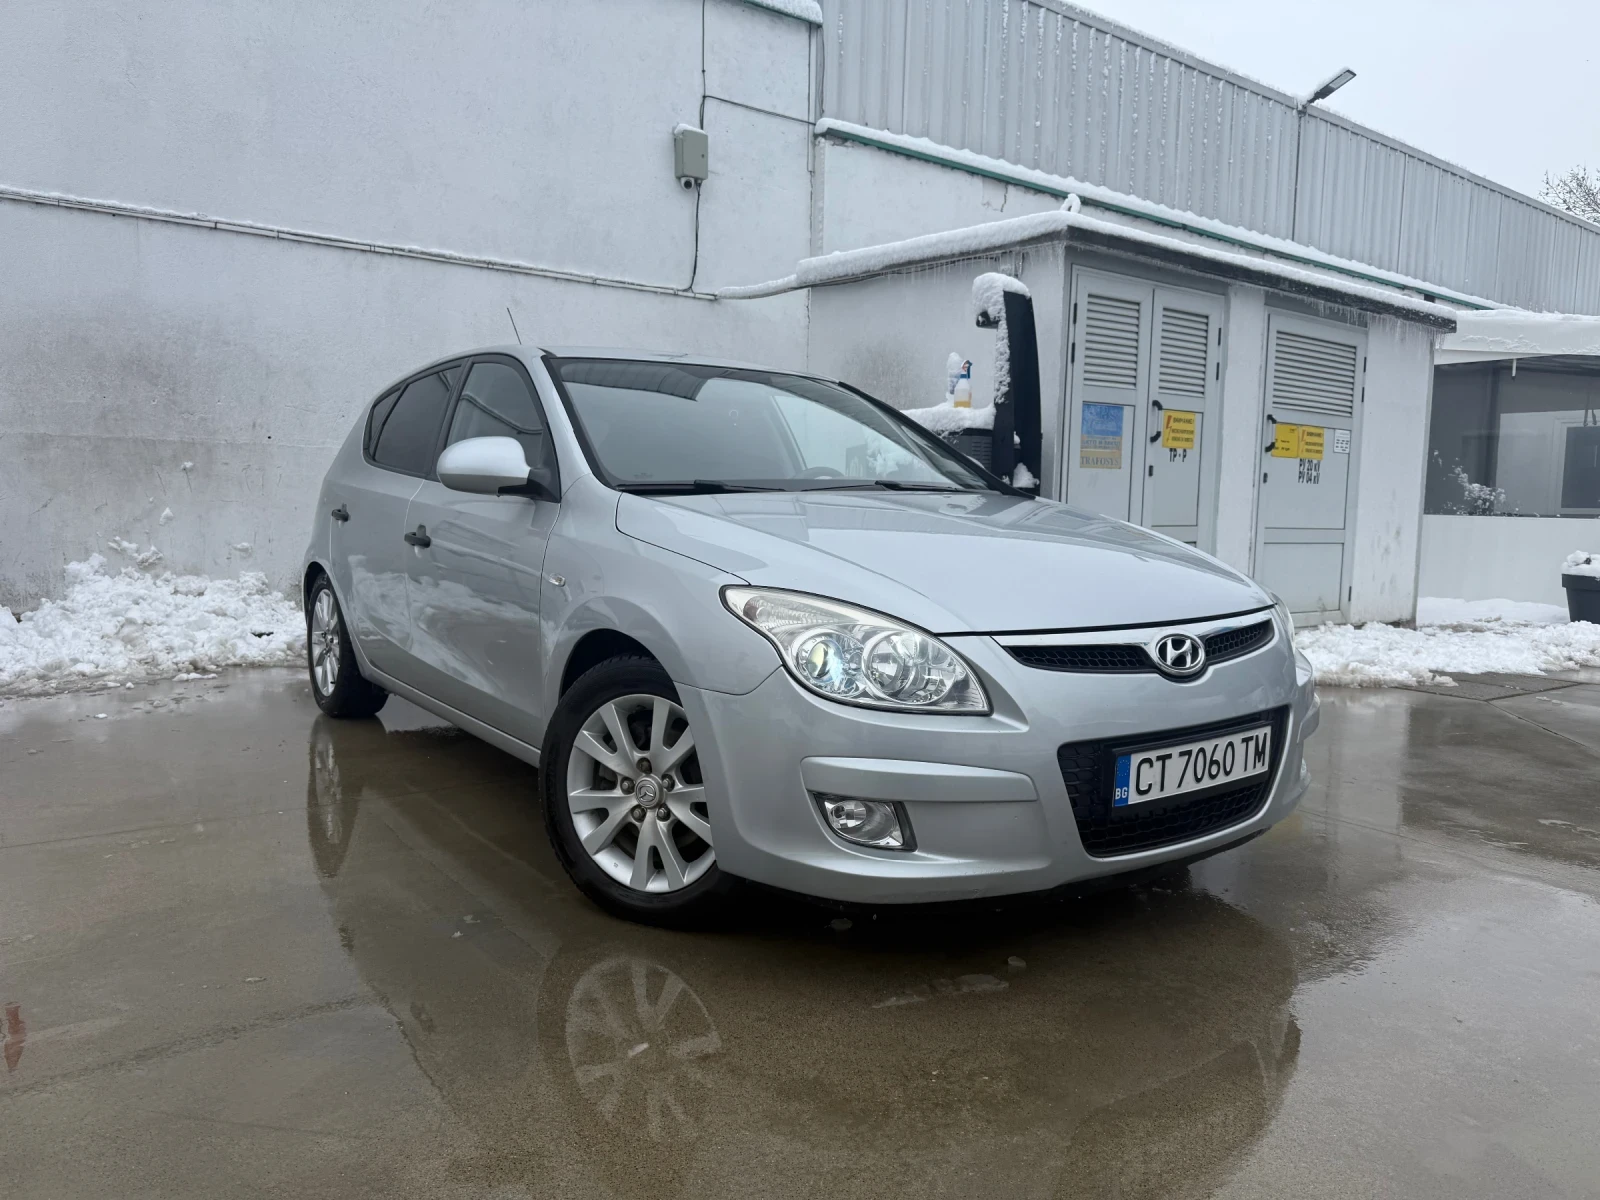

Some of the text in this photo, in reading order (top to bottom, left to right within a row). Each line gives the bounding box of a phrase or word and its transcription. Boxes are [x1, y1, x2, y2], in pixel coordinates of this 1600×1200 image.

[1081, 456, 1119, 466] TRAFOSYS
[1136, 732, 1267, 795] CT 7060 TM
[1115, 787, 1128, 800] BG
